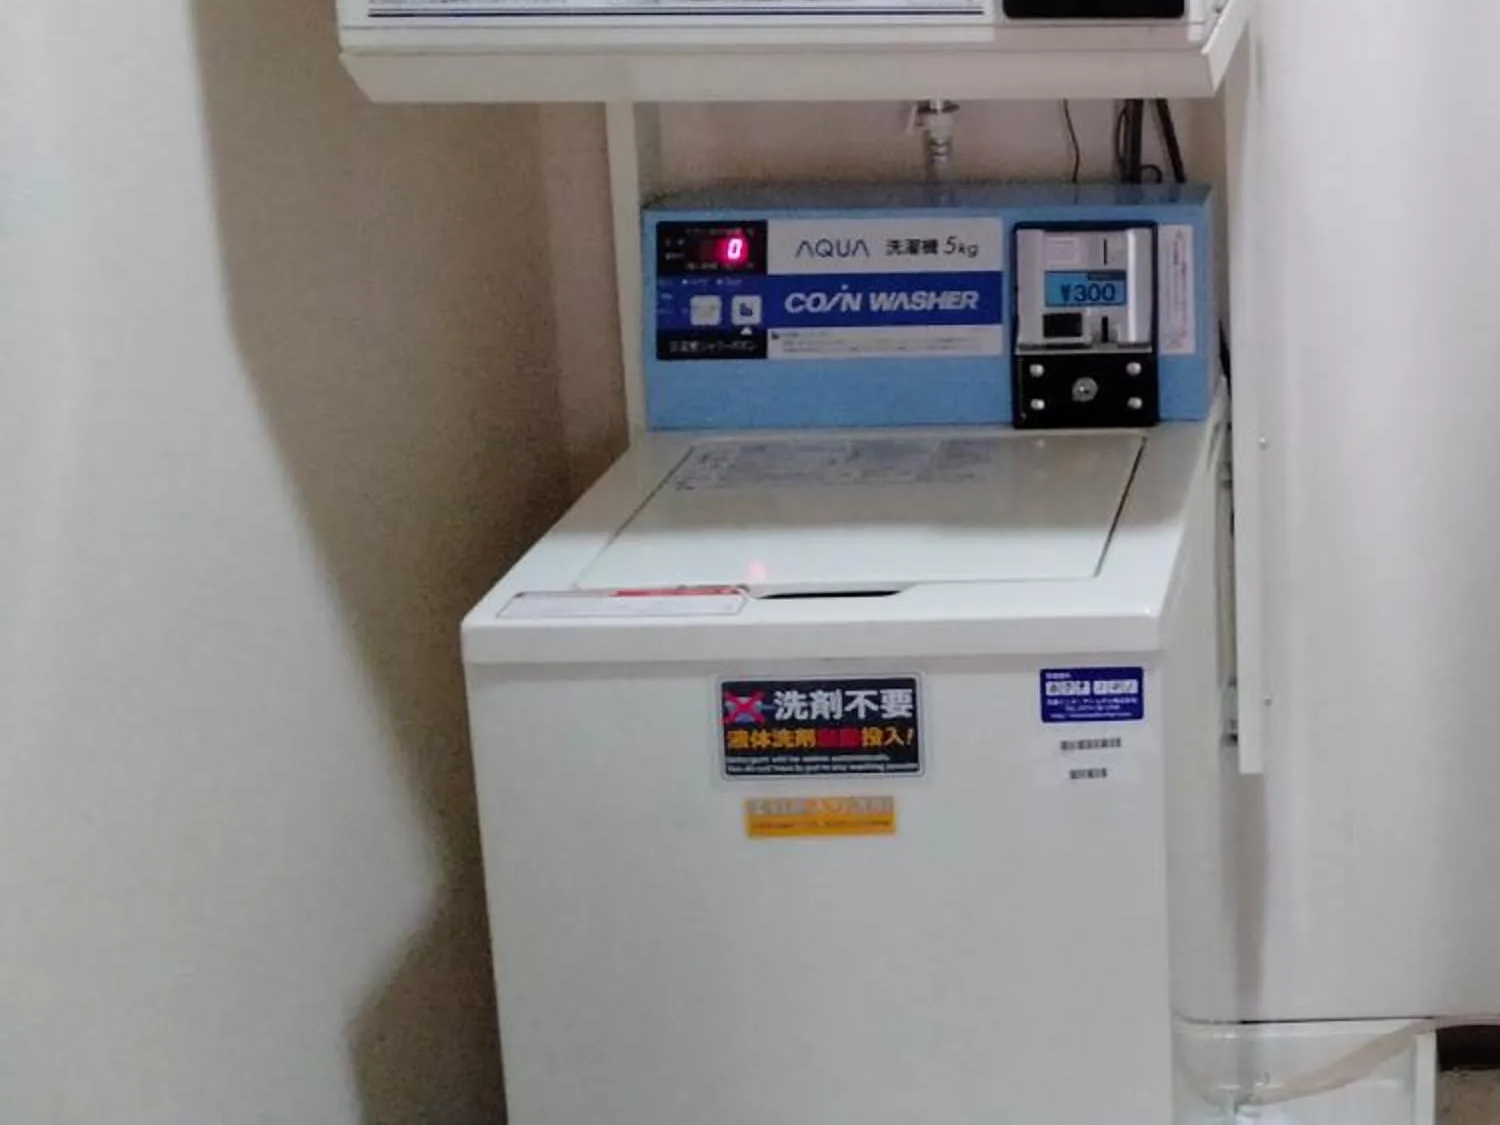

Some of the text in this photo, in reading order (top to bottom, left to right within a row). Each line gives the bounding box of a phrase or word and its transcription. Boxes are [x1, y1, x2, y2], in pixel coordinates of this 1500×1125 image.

[795, 238, 871, 258] AQUA
[886, 236, 938, 255] 洗濯機
[784, 284, 981, 313] COIN WASHER
[1060, 282, 1117, 302] ¥300
[773, 688, 914, 721] 洗剤不要
